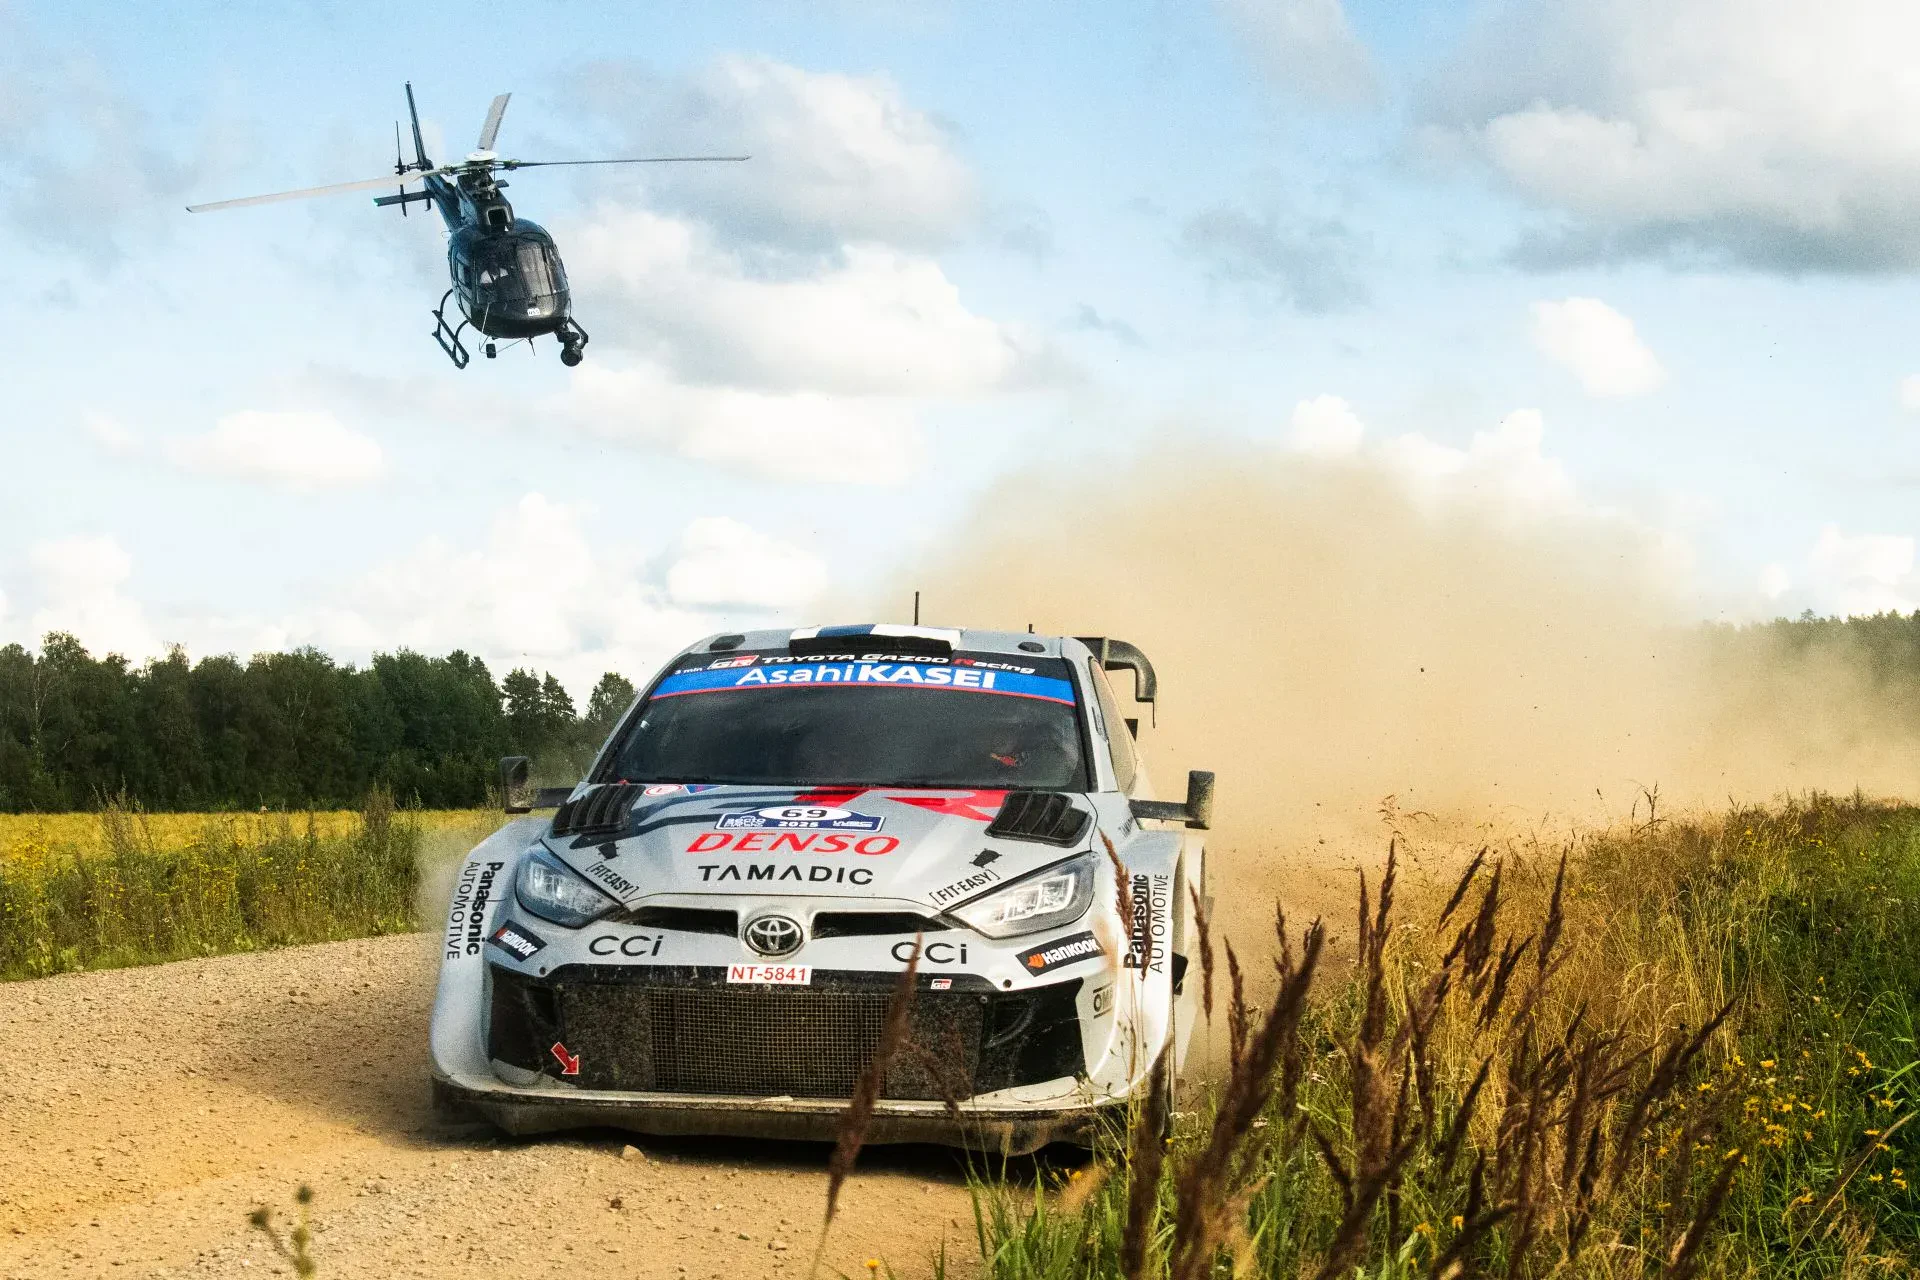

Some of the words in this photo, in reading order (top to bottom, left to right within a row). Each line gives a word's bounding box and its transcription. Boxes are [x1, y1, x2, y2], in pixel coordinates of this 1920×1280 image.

[762, 654, 855, 664] TOYOTA
[861, 653, 949, 664] GAZOO
[952, 658, 1036, 675] Racing
[778, 820, 819, 828] 2025
[781, 809, 828, 819] 69
[686, 832, 900, 856] DENSO
[698, 864, 874, 886] TAMADIC
[446, 862, 480, 960] AUTOMOTIVE
[466, 862, 505, 956] Panasonic
[1150, 874, 1168, 974] AUTOMOTIVE
[731, 966, 806, 982] NT-5841
